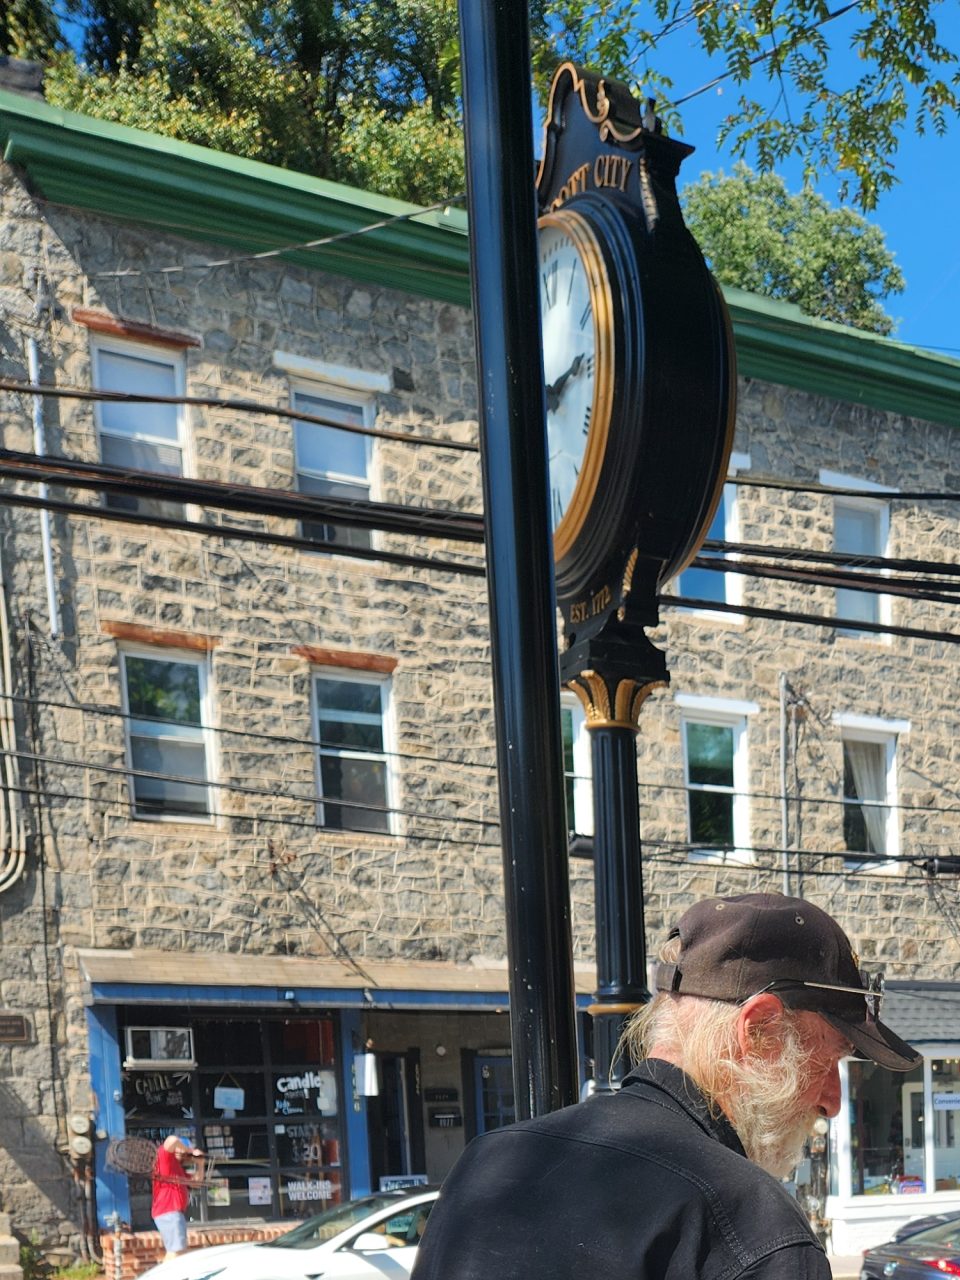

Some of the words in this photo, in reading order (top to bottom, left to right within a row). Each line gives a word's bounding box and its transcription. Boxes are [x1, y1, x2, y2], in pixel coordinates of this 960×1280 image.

[594, 154, 632, 193] CITY
[570, 601, 589, 624] EST.
[287, 1180, 331, 1192] WALK-INS
[288, 1190, 332, 1201] WELCOME
